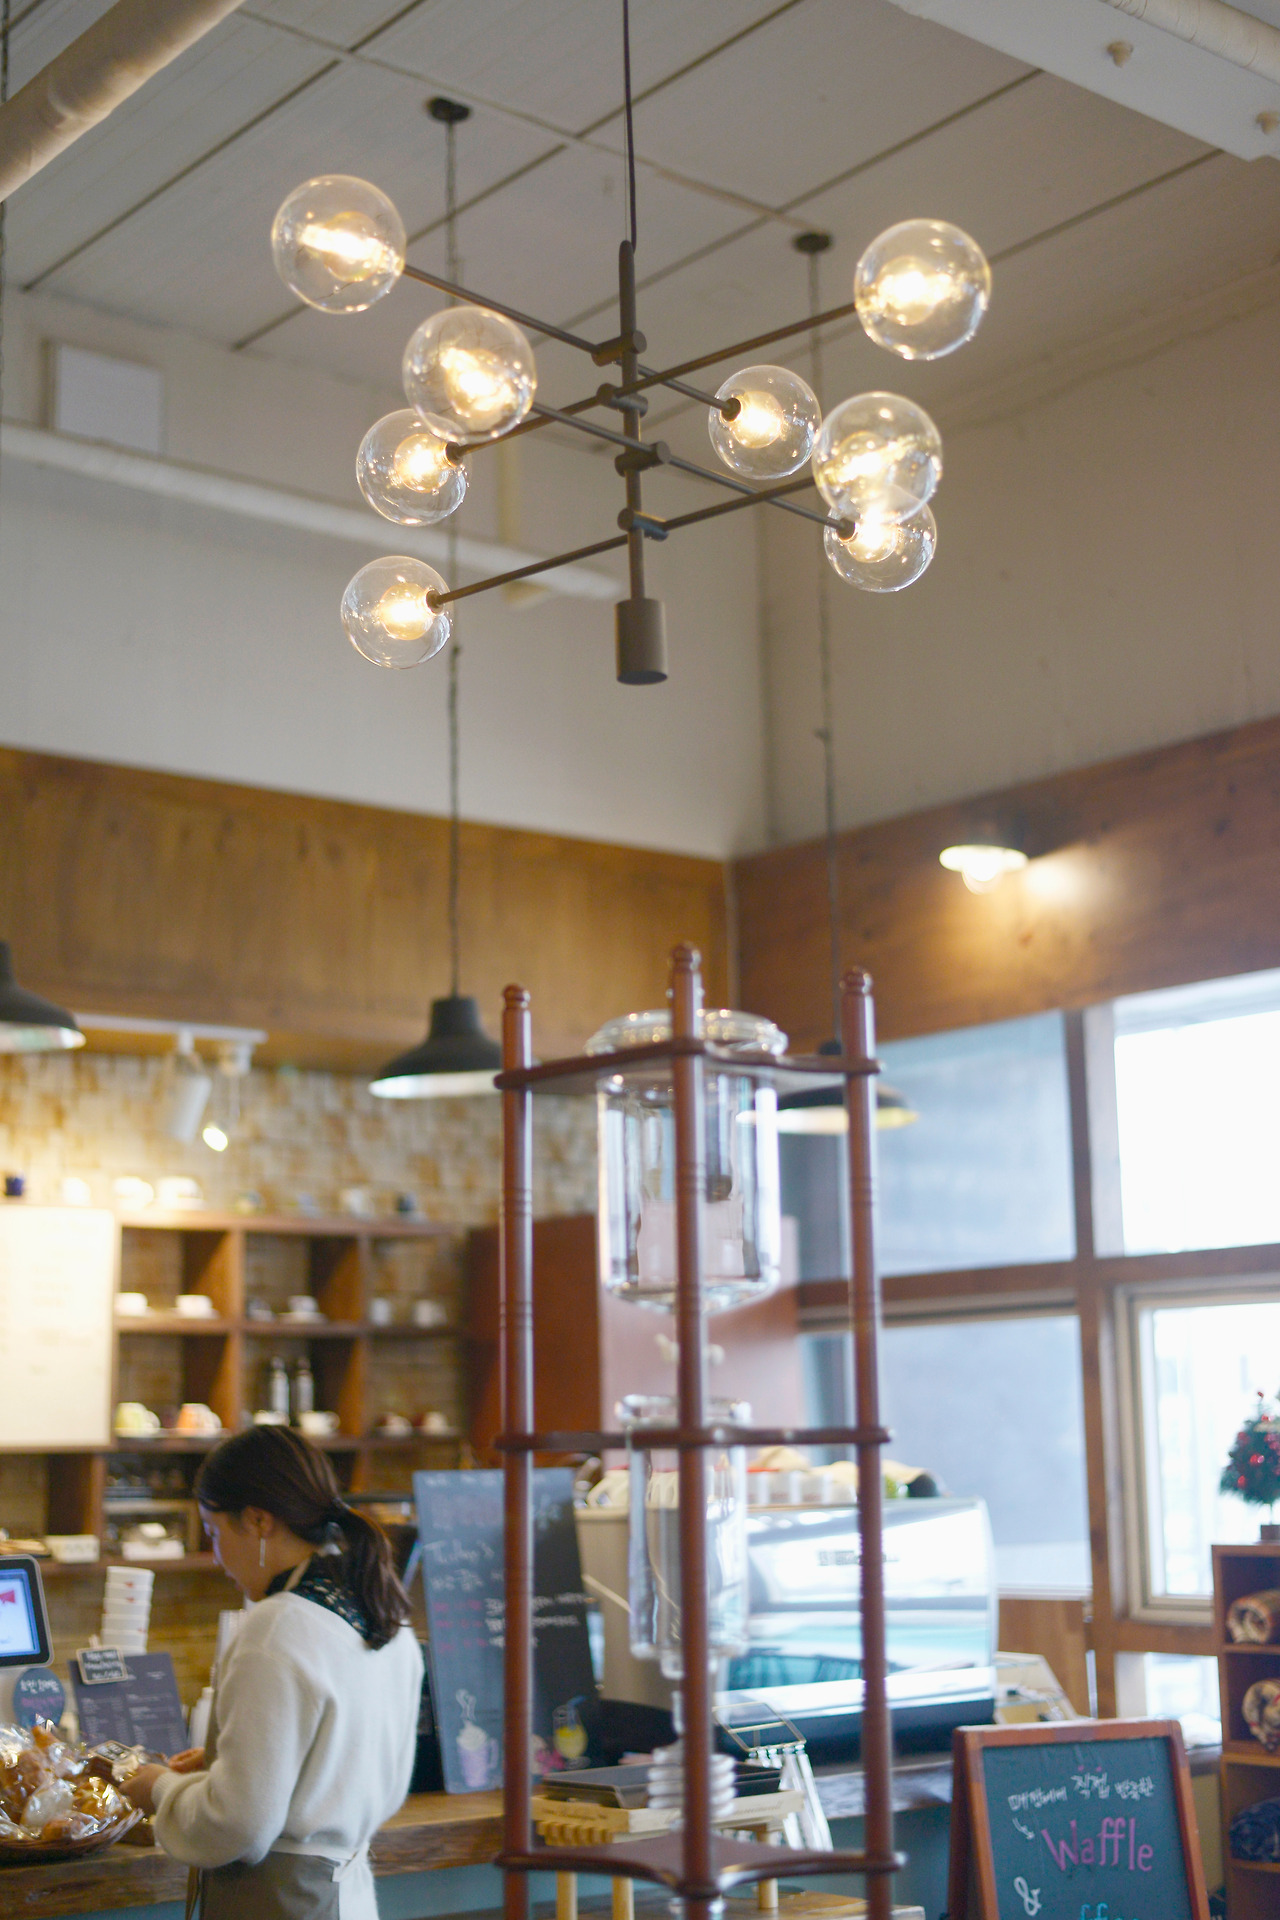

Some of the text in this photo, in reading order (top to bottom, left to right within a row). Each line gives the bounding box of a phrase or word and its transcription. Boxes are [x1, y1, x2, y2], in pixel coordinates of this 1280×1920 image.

[1071, 1772, 1110, 1799] 직접
[1041, 1816, 1153, 1872] Waffle
[1013, 1876, 1042, 1916] &
